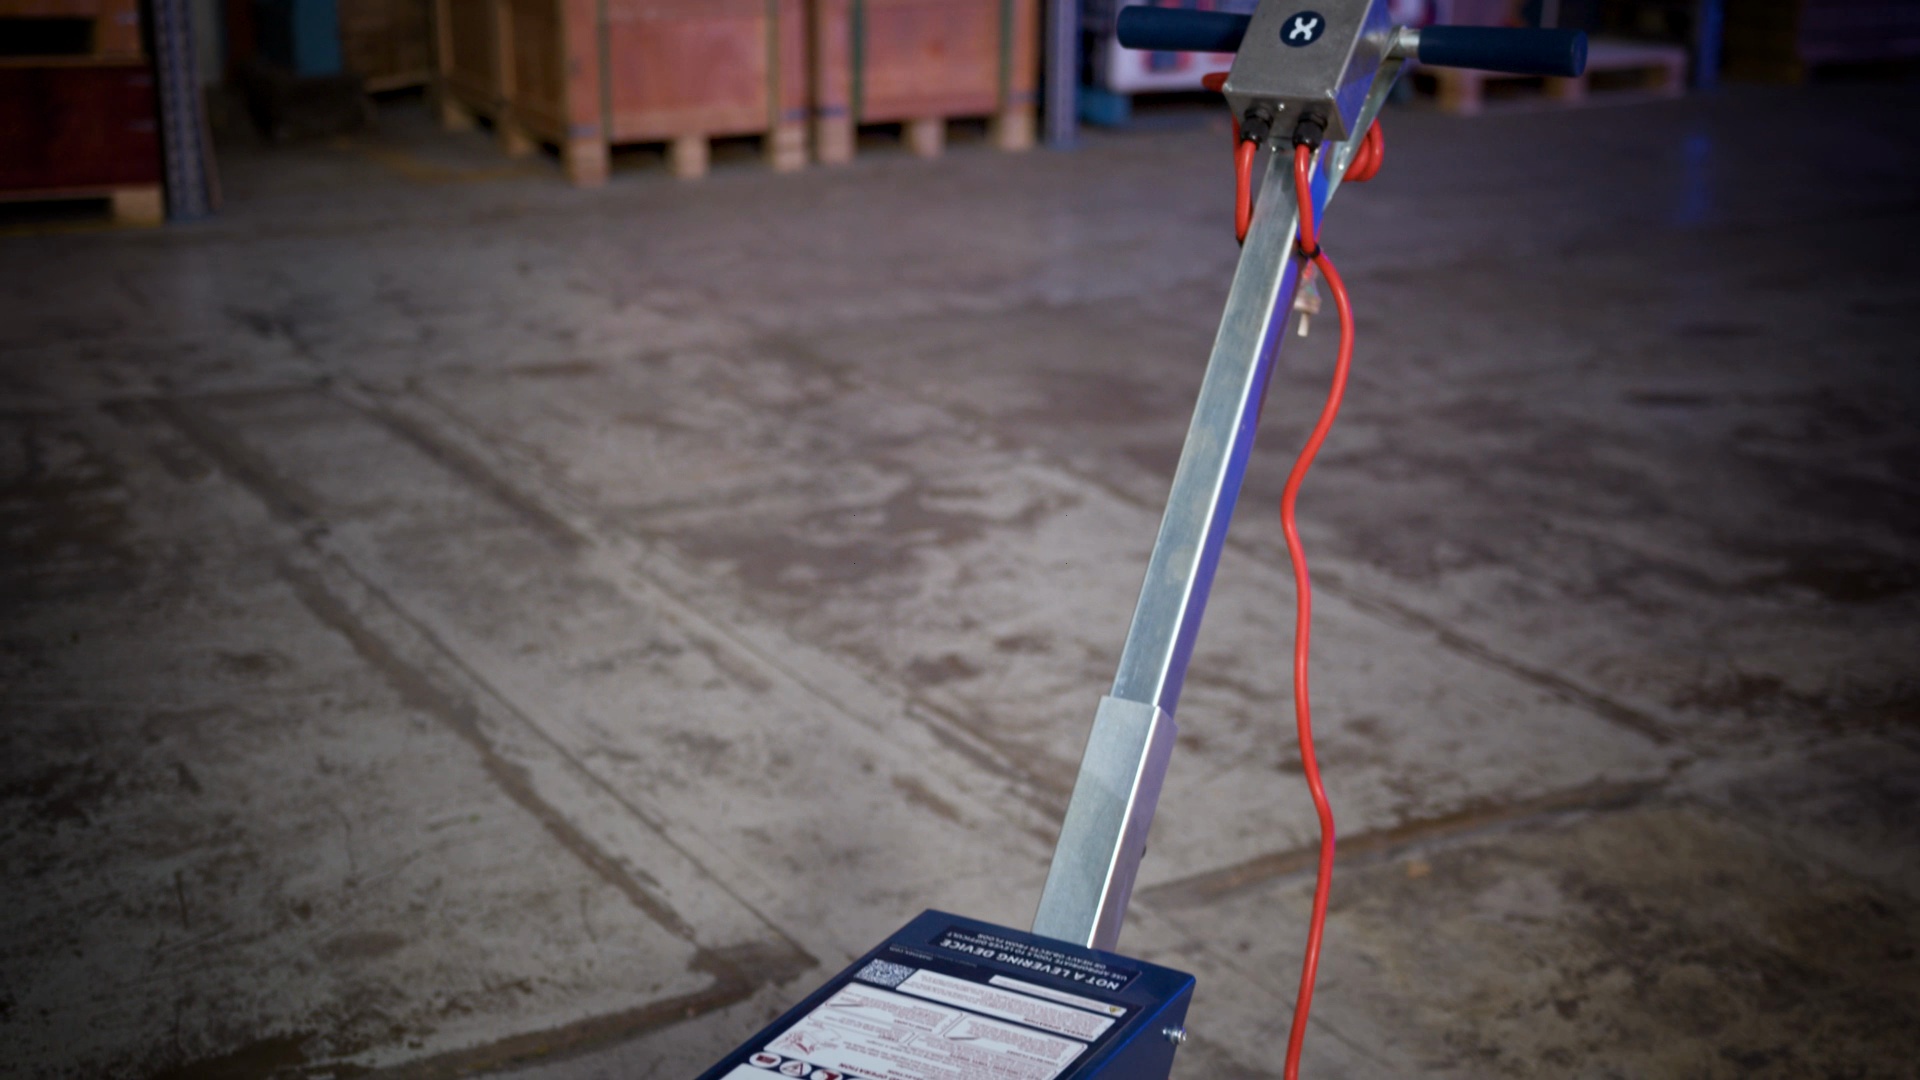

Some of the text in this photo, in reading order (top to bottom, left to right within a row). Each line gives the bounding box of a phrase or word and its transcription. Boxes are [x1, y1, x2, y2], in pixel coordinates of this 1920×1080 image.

[946, 931, 988, 948] DIFFICULT
[977, 933, 1004, 944] FLOOR
[1005, 939, 1029, 950] FROM
[940, 939, 996, 958] DEVICE
[988, 941, 1014, 953] LEVER
[1030, 947, 1065, 959] OBJECTS
[1027, 951, 1053, 963] TOOLS
[1066, 955, 1093, 967] HEAVY
[996, 953, 1071, 978] LEVERING
[1055, 959, 1110, 977] APPROPRIATE
[1074, 971, 1086, 981] A
[1110, 972, 1128, 981] USE
[1085, 976, 1119, 990] NOT
